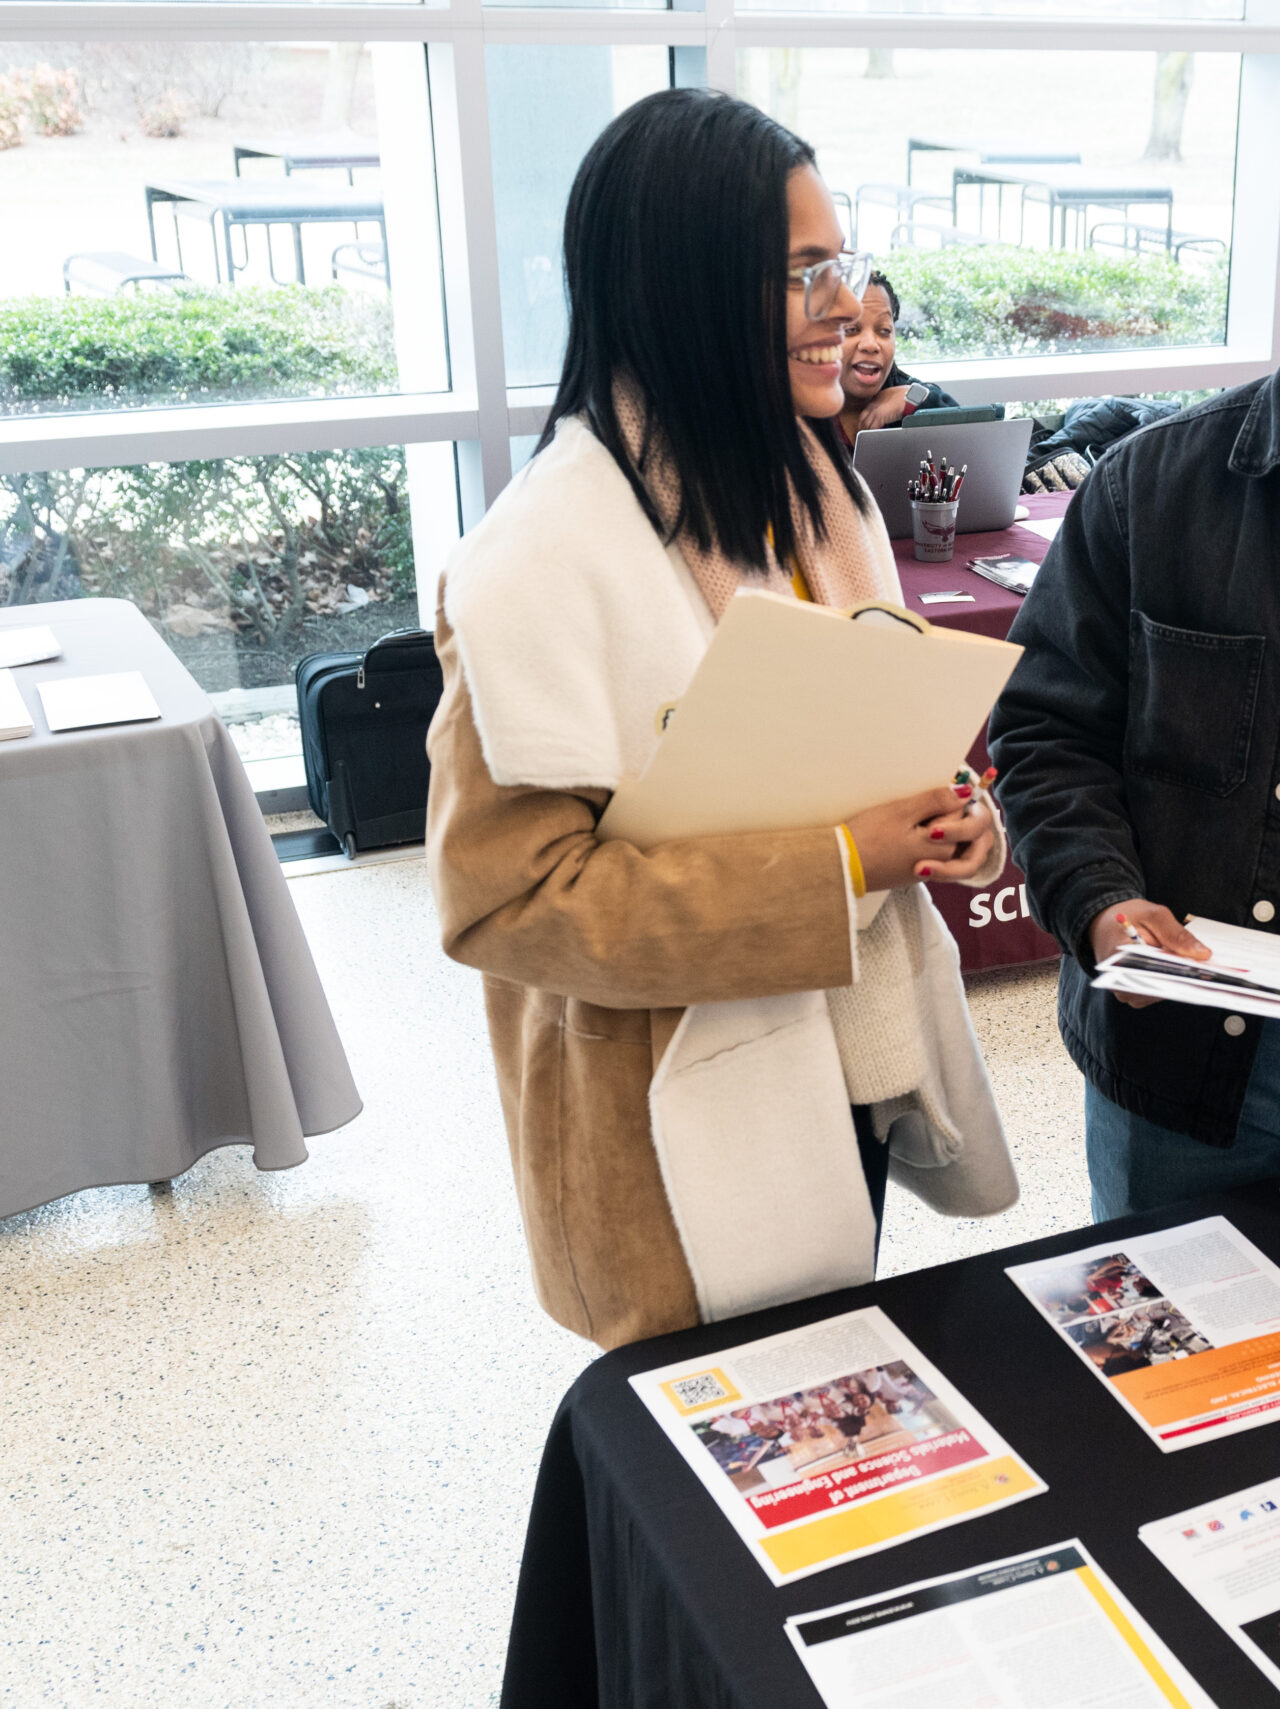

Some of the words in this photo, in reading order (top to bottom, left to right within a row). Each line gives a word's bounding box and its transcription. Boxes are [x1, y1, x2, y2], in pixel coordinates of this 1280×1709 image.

[911, 1429, 972, 1458] Materials
[831, 1462, 857, 1483] and
[858, 1448, 911, 1474] Science
[750, 1473, 831, 1511] Engineering
[846, 1463, 922, 1499] Department
